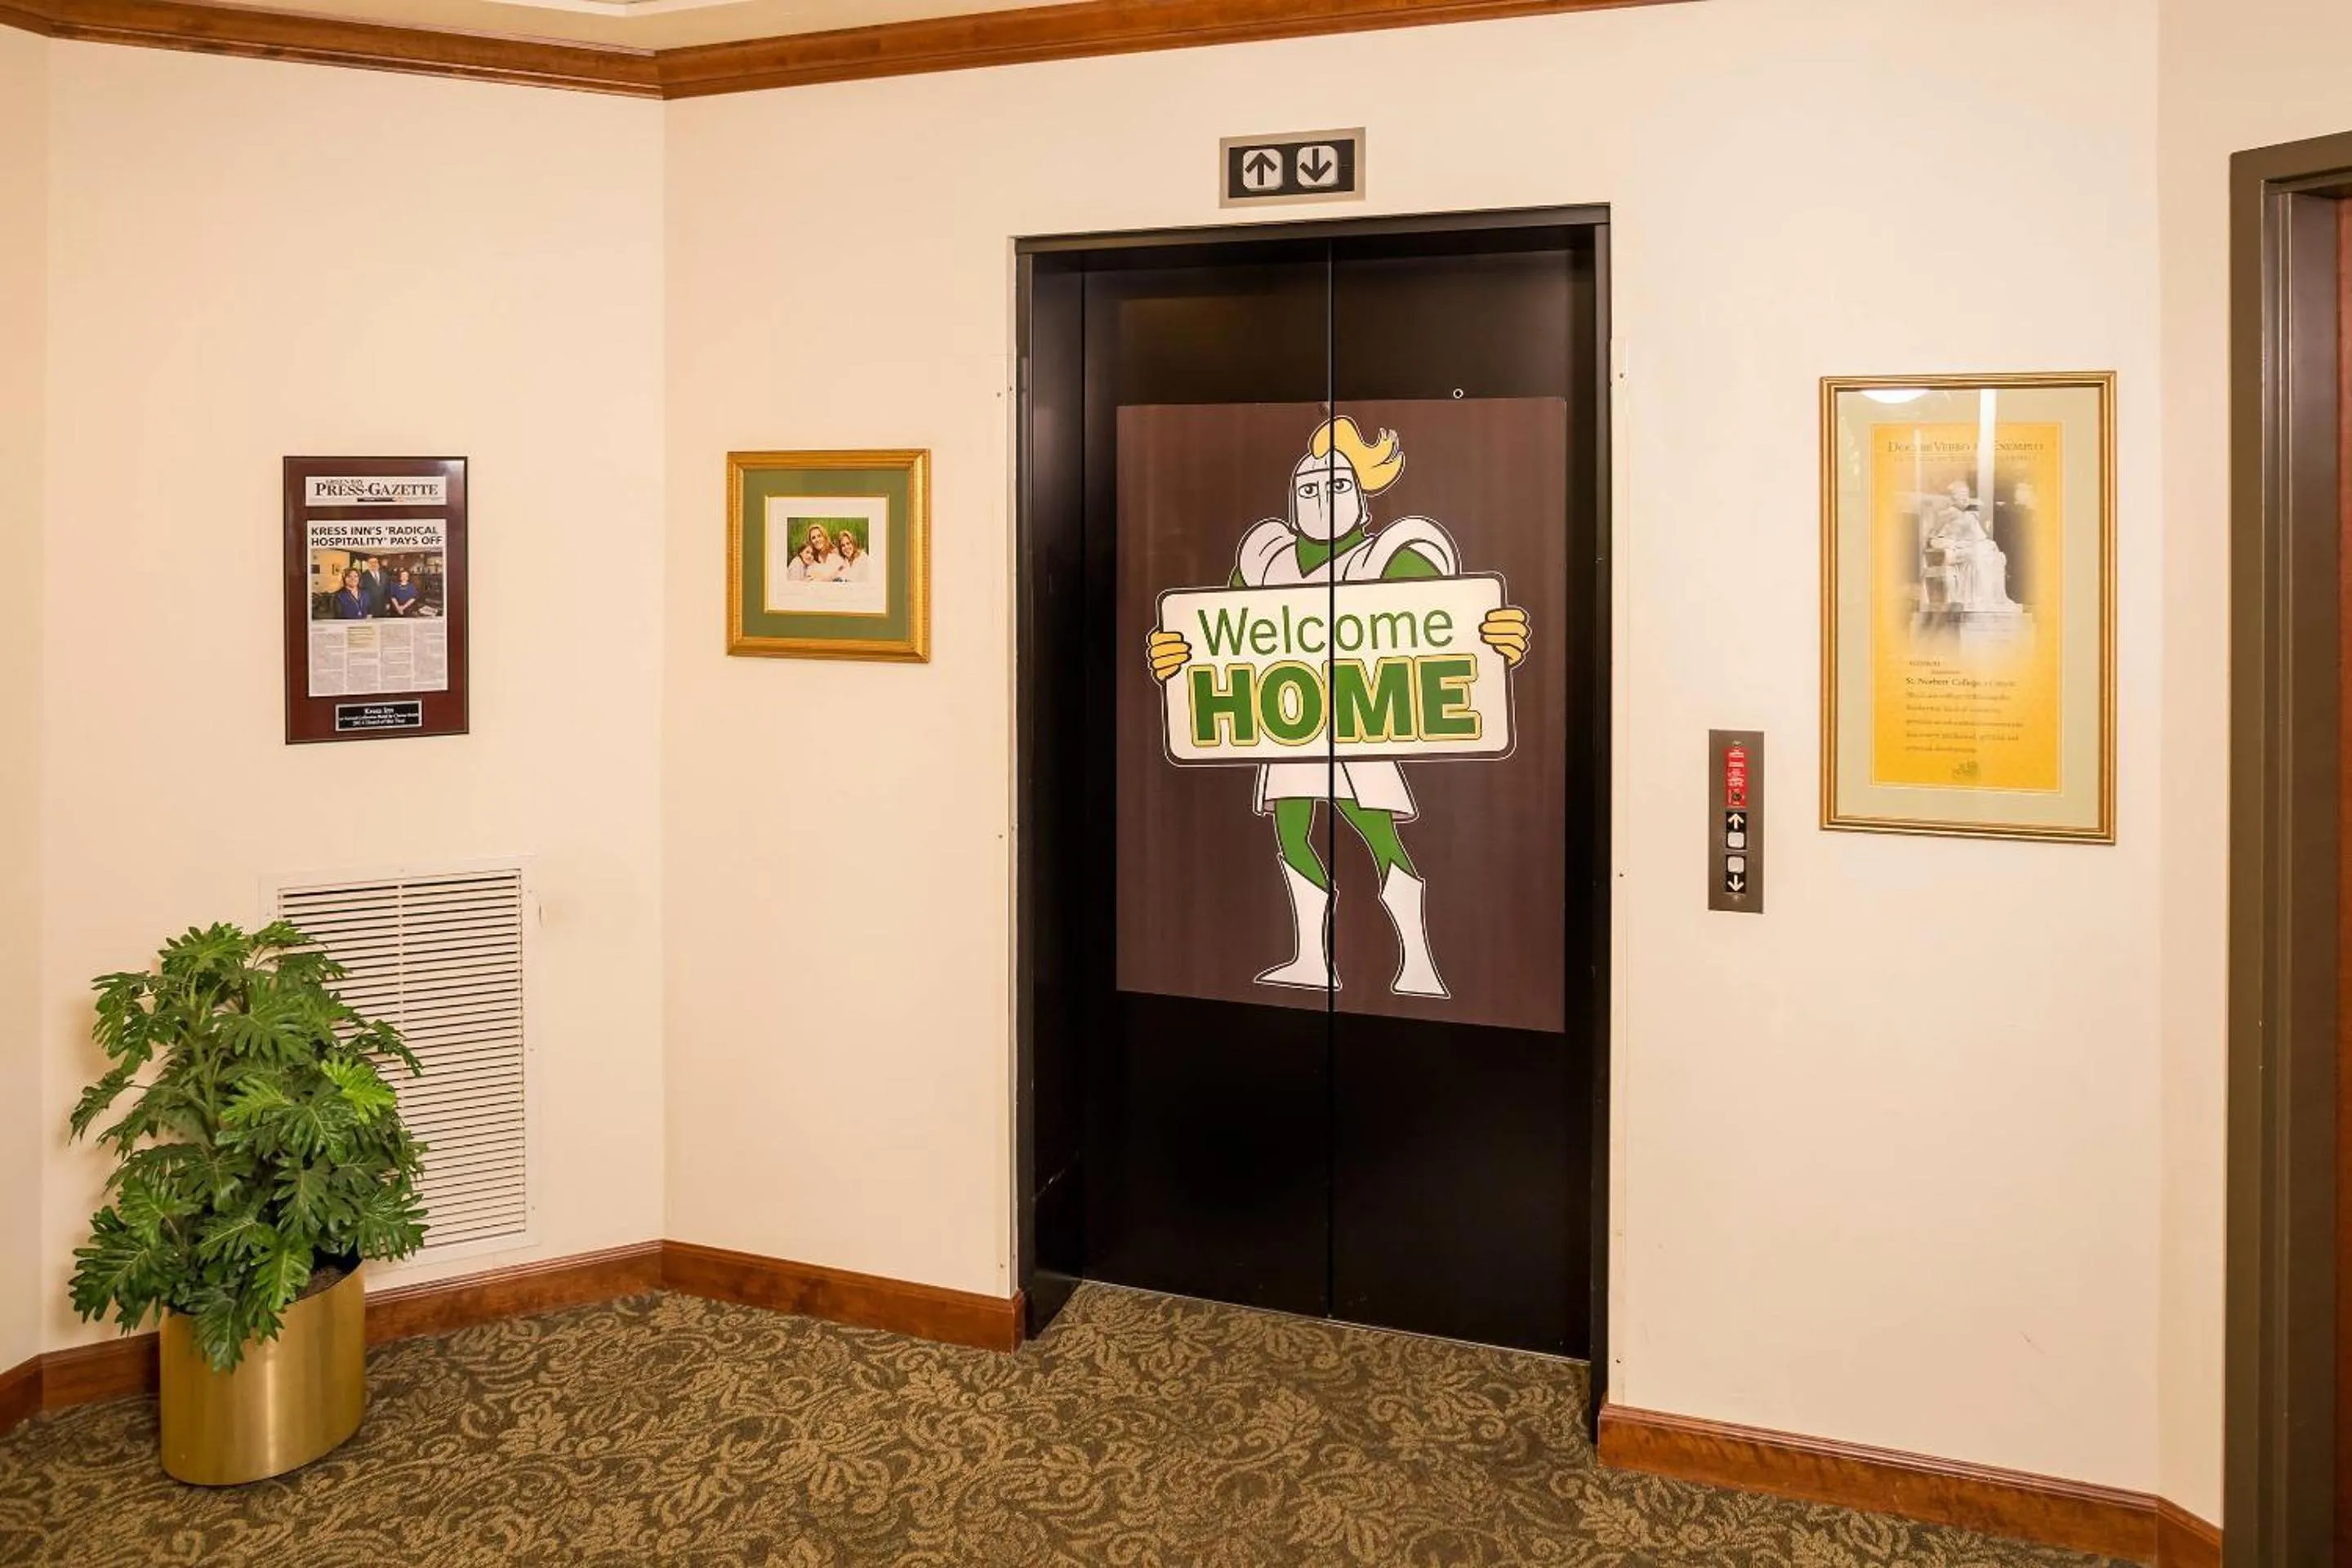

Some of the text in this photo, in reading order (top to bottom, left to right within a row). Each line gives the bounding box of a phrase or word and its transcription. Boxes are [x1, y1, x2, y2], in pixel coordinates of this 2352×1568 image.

[311, 526, 348, 536] KRESS
[350, 526, 382, 536] INN'S
[390, 536, 418, 546] PAYS
[421, 536, 443, 545] OFF
[1197, 604, 1454, 657] Welcome
[1187, 653, 1483, 746] HOME
